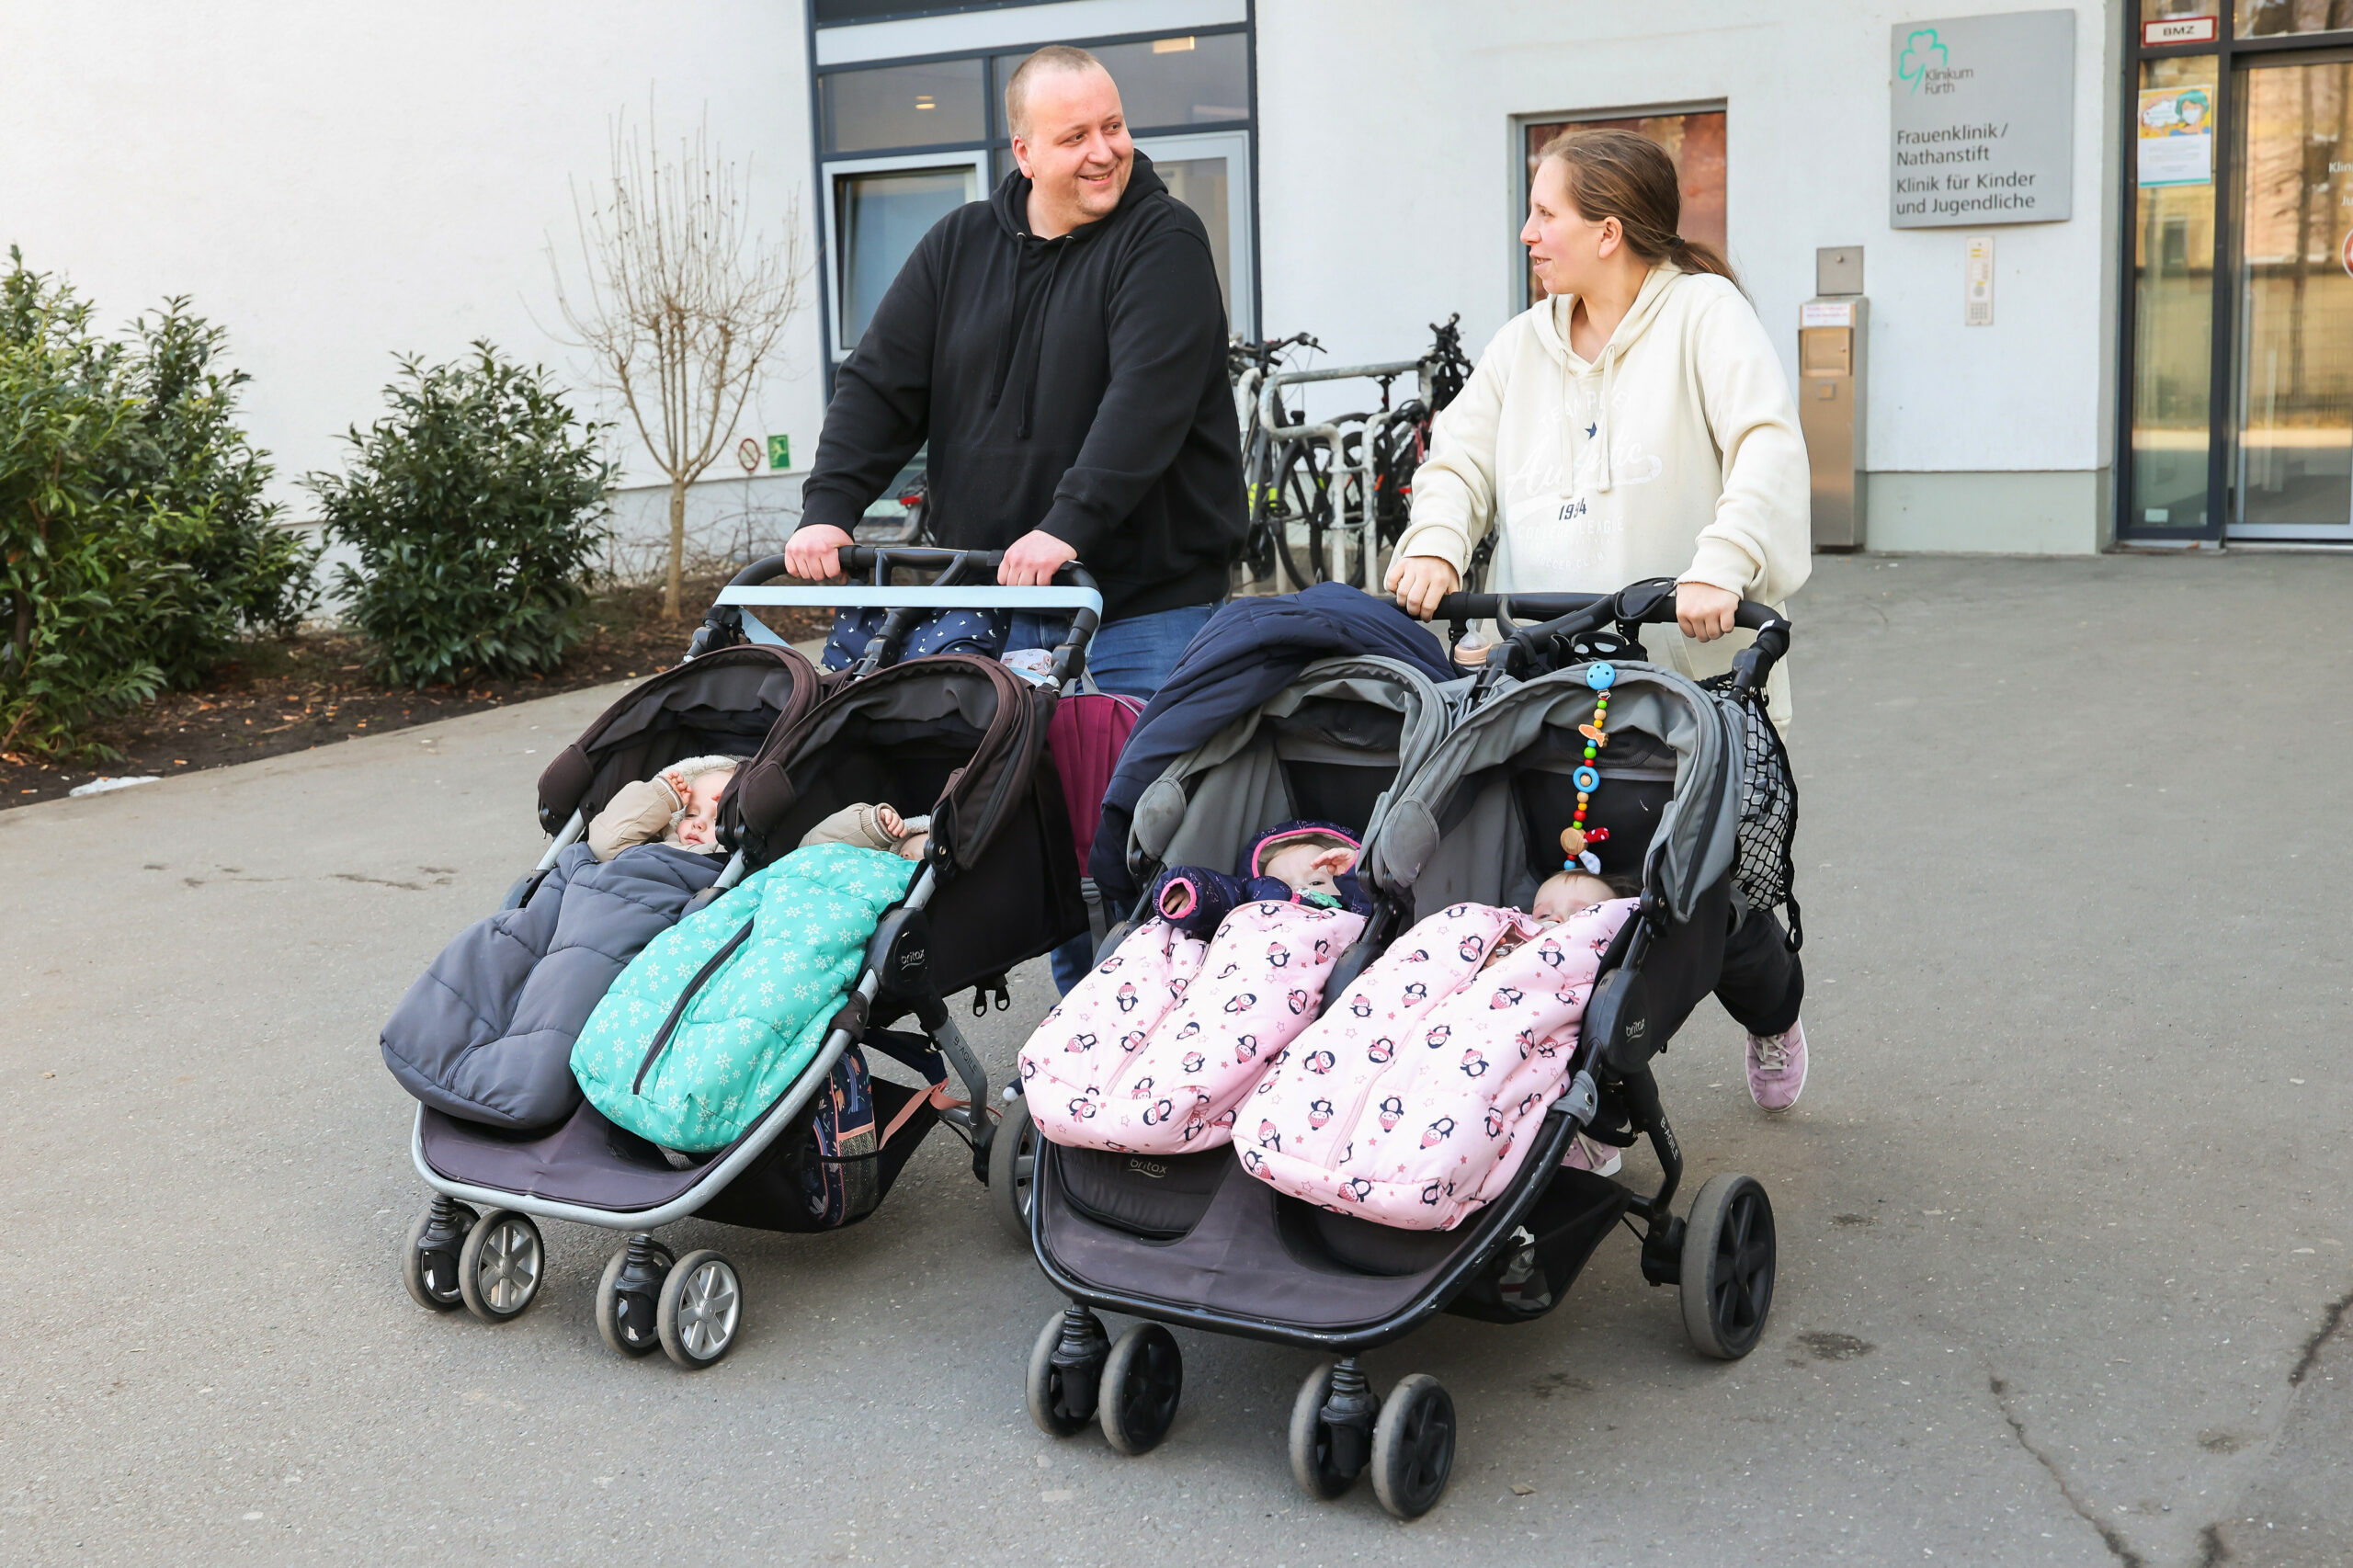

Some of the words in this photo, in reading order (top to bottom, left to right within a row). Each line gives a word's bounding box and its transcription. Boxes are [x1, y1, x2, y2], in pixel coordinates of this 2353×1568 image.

[2163, 26, 2195, 37] BMZ
[1925, 67, 1974, 81] Klinikum
[1925, 81, 1955, 94] Fürth
[1897, 144, 1990, 166] Nathanstift
[1896, 176, 1939, 193] Klinik
[1947, 174, 1970, 190] für
[1977, 170, 2036, 189] Kinder
[1896, 198, 1926, 215] und
[1932, 193, 2036, 217] Jugendliche
[952, 1036, 978, 1074] B-AGILE
[1660, 1116, 1679, 1161] B-AGILE
[1130, 1158, 1168, 1174] britax
